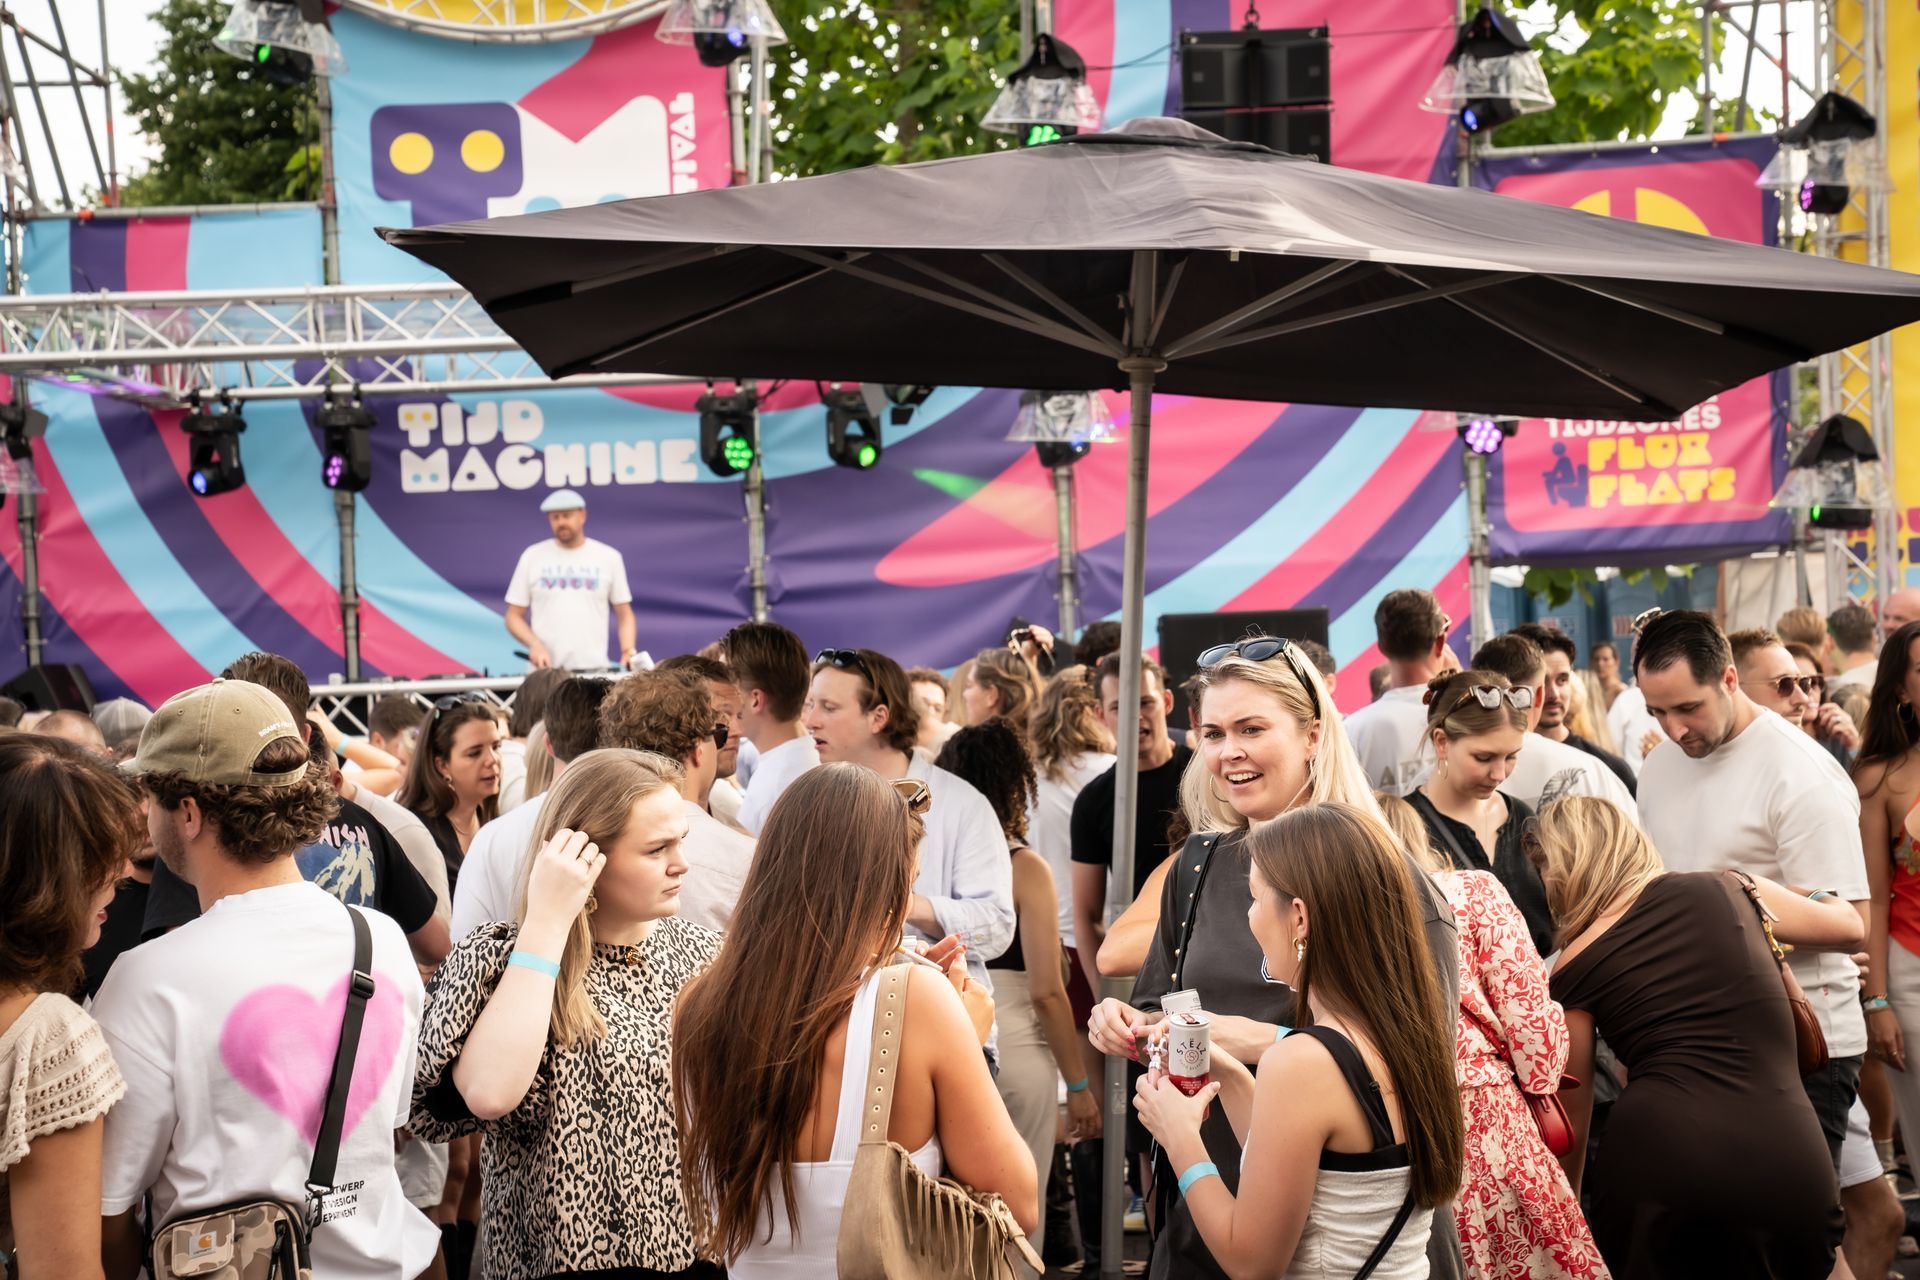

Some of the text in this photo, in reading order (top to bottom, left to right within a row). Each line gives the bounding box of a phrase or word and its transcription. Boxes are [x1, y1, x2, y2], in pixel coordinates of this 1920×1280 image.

[669, 92, 699, 195] TIVAL
[398, 400, 544, 447] TIJD
[400, 438, 698, 493] MACHINE
[1588, 432, 1713, 471] FLUX
[1588, 467, 1736, 508] FLATS
